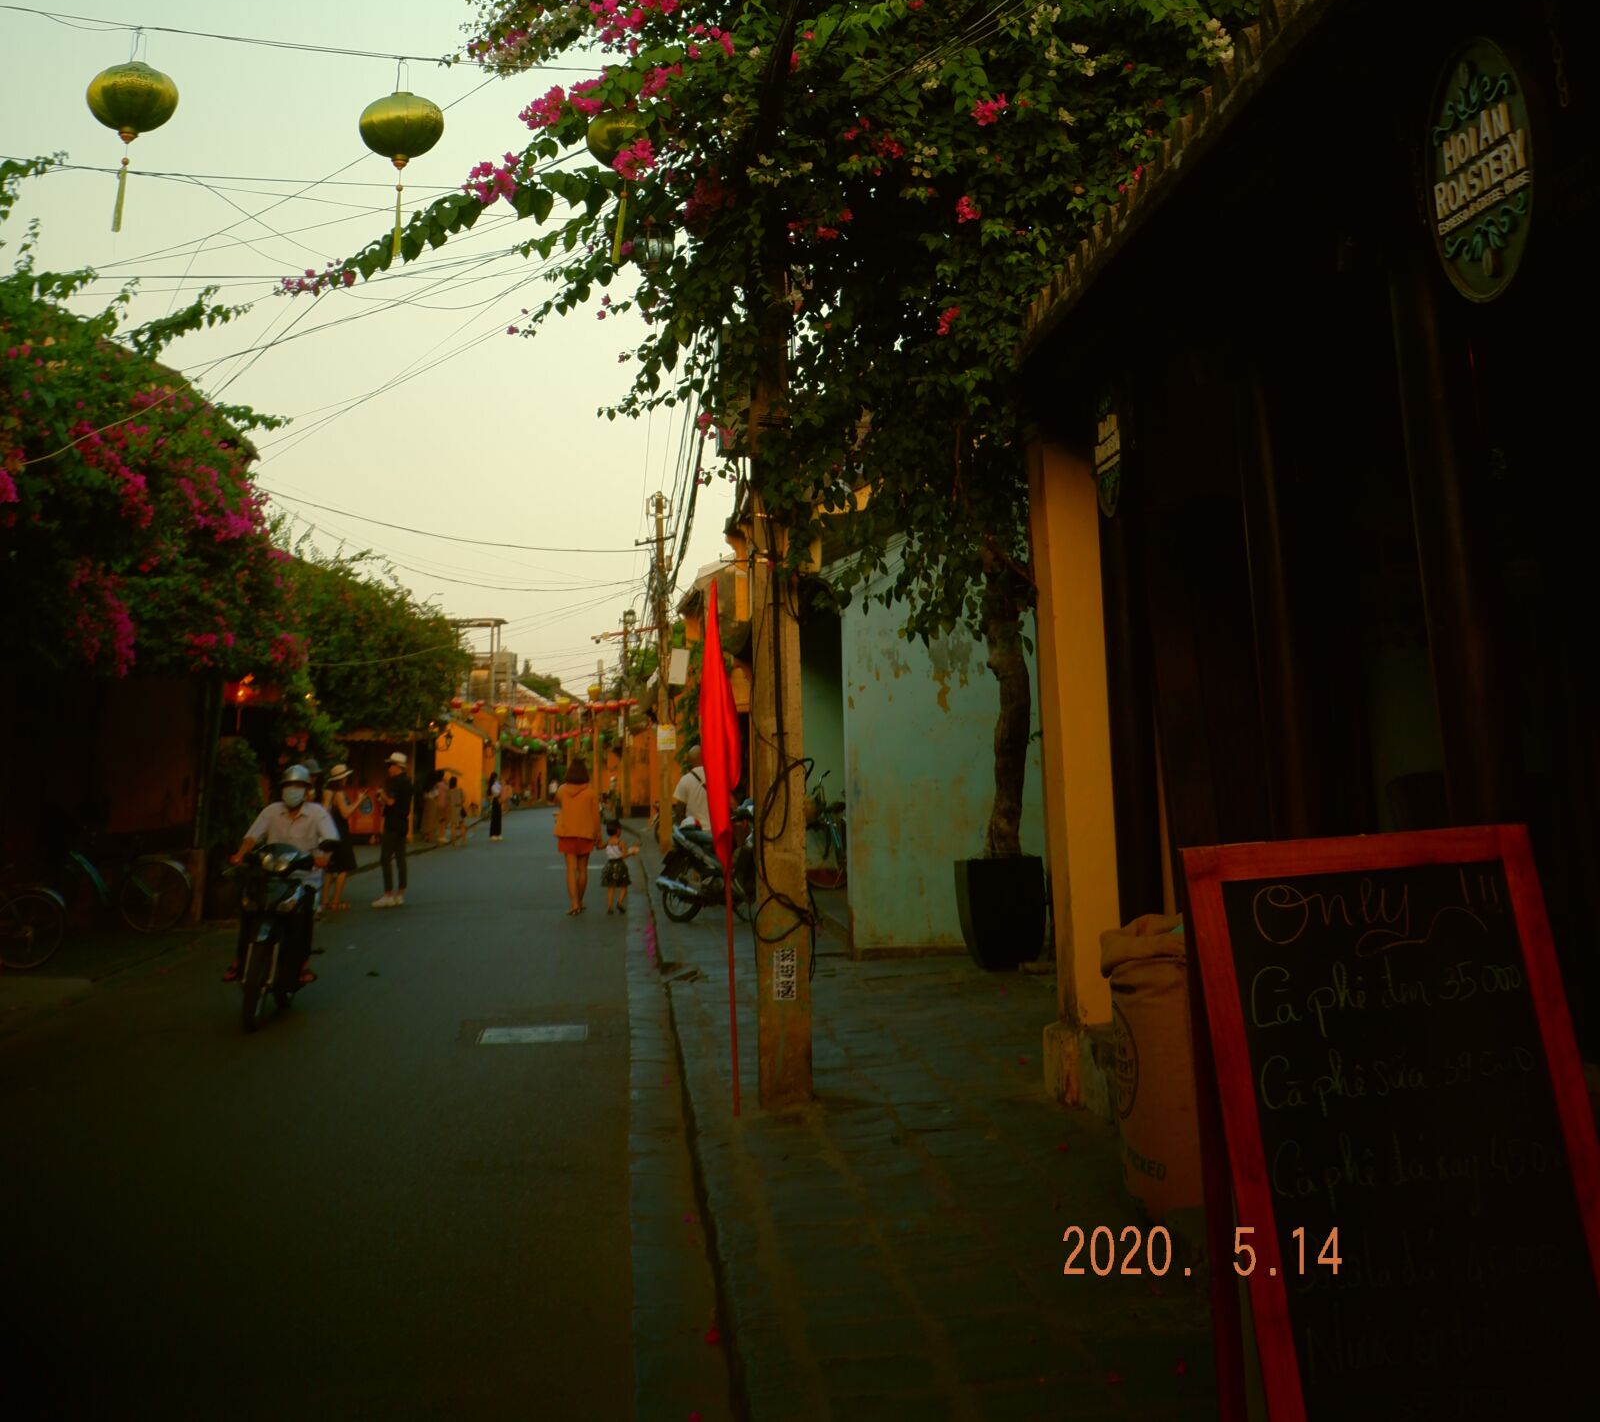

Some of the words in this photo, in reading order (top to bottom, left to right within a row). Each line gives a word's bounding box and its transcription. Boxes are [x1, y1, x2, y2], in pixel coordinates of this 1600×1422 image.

[1433, 129, 1527, 219] ROASTERY
[1442, 126, 1479, 175] HOI
[1480, 102, 1513, 151] AN
[1253, 878, 1410, 946] Only
